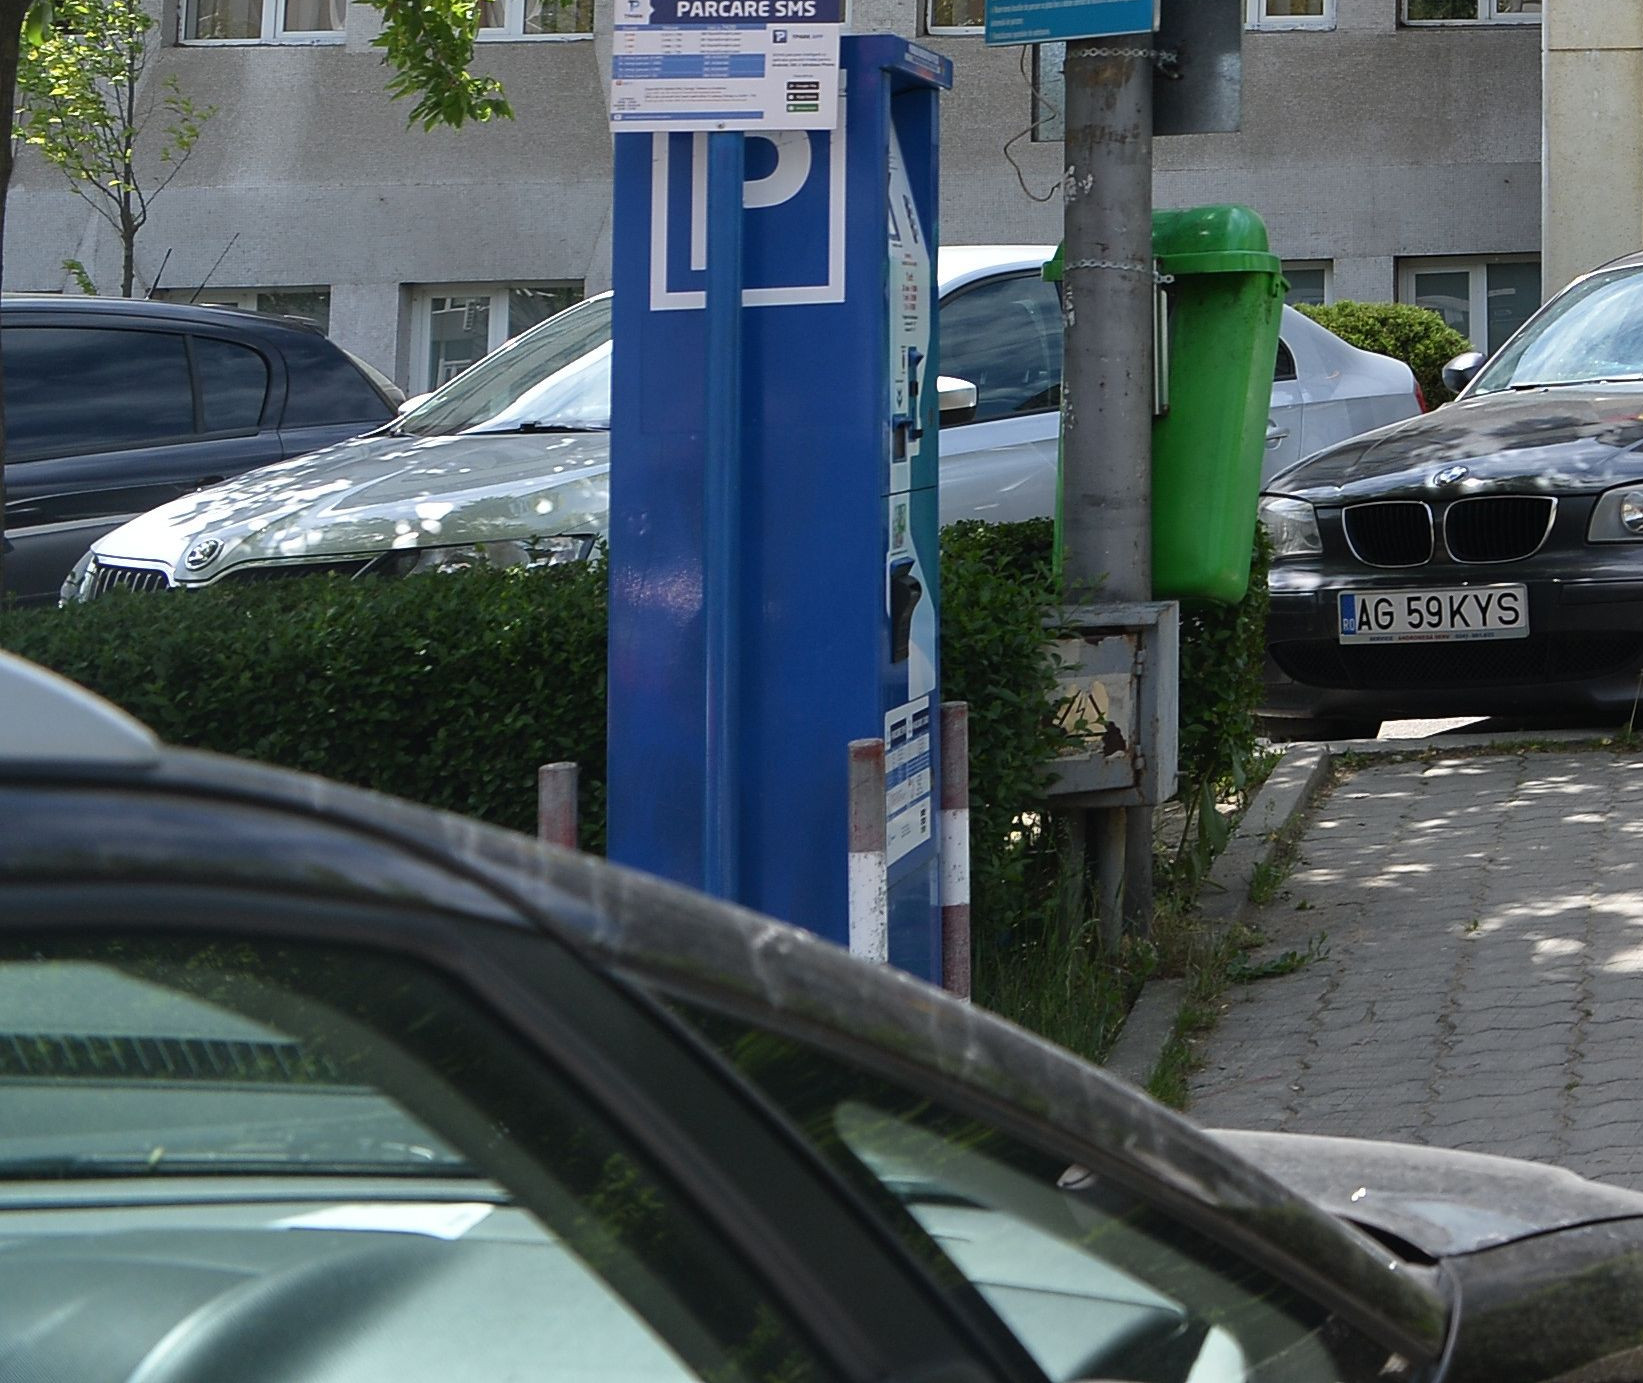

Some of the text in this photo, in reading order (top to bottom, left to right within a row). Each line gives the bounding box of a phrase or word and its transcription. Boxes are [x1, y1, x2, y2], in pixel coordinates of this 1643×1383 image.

[677, 0, 817, 17] PARCARE SMS
[1343, 592, 1521, 632] RO AG 59 KYS
